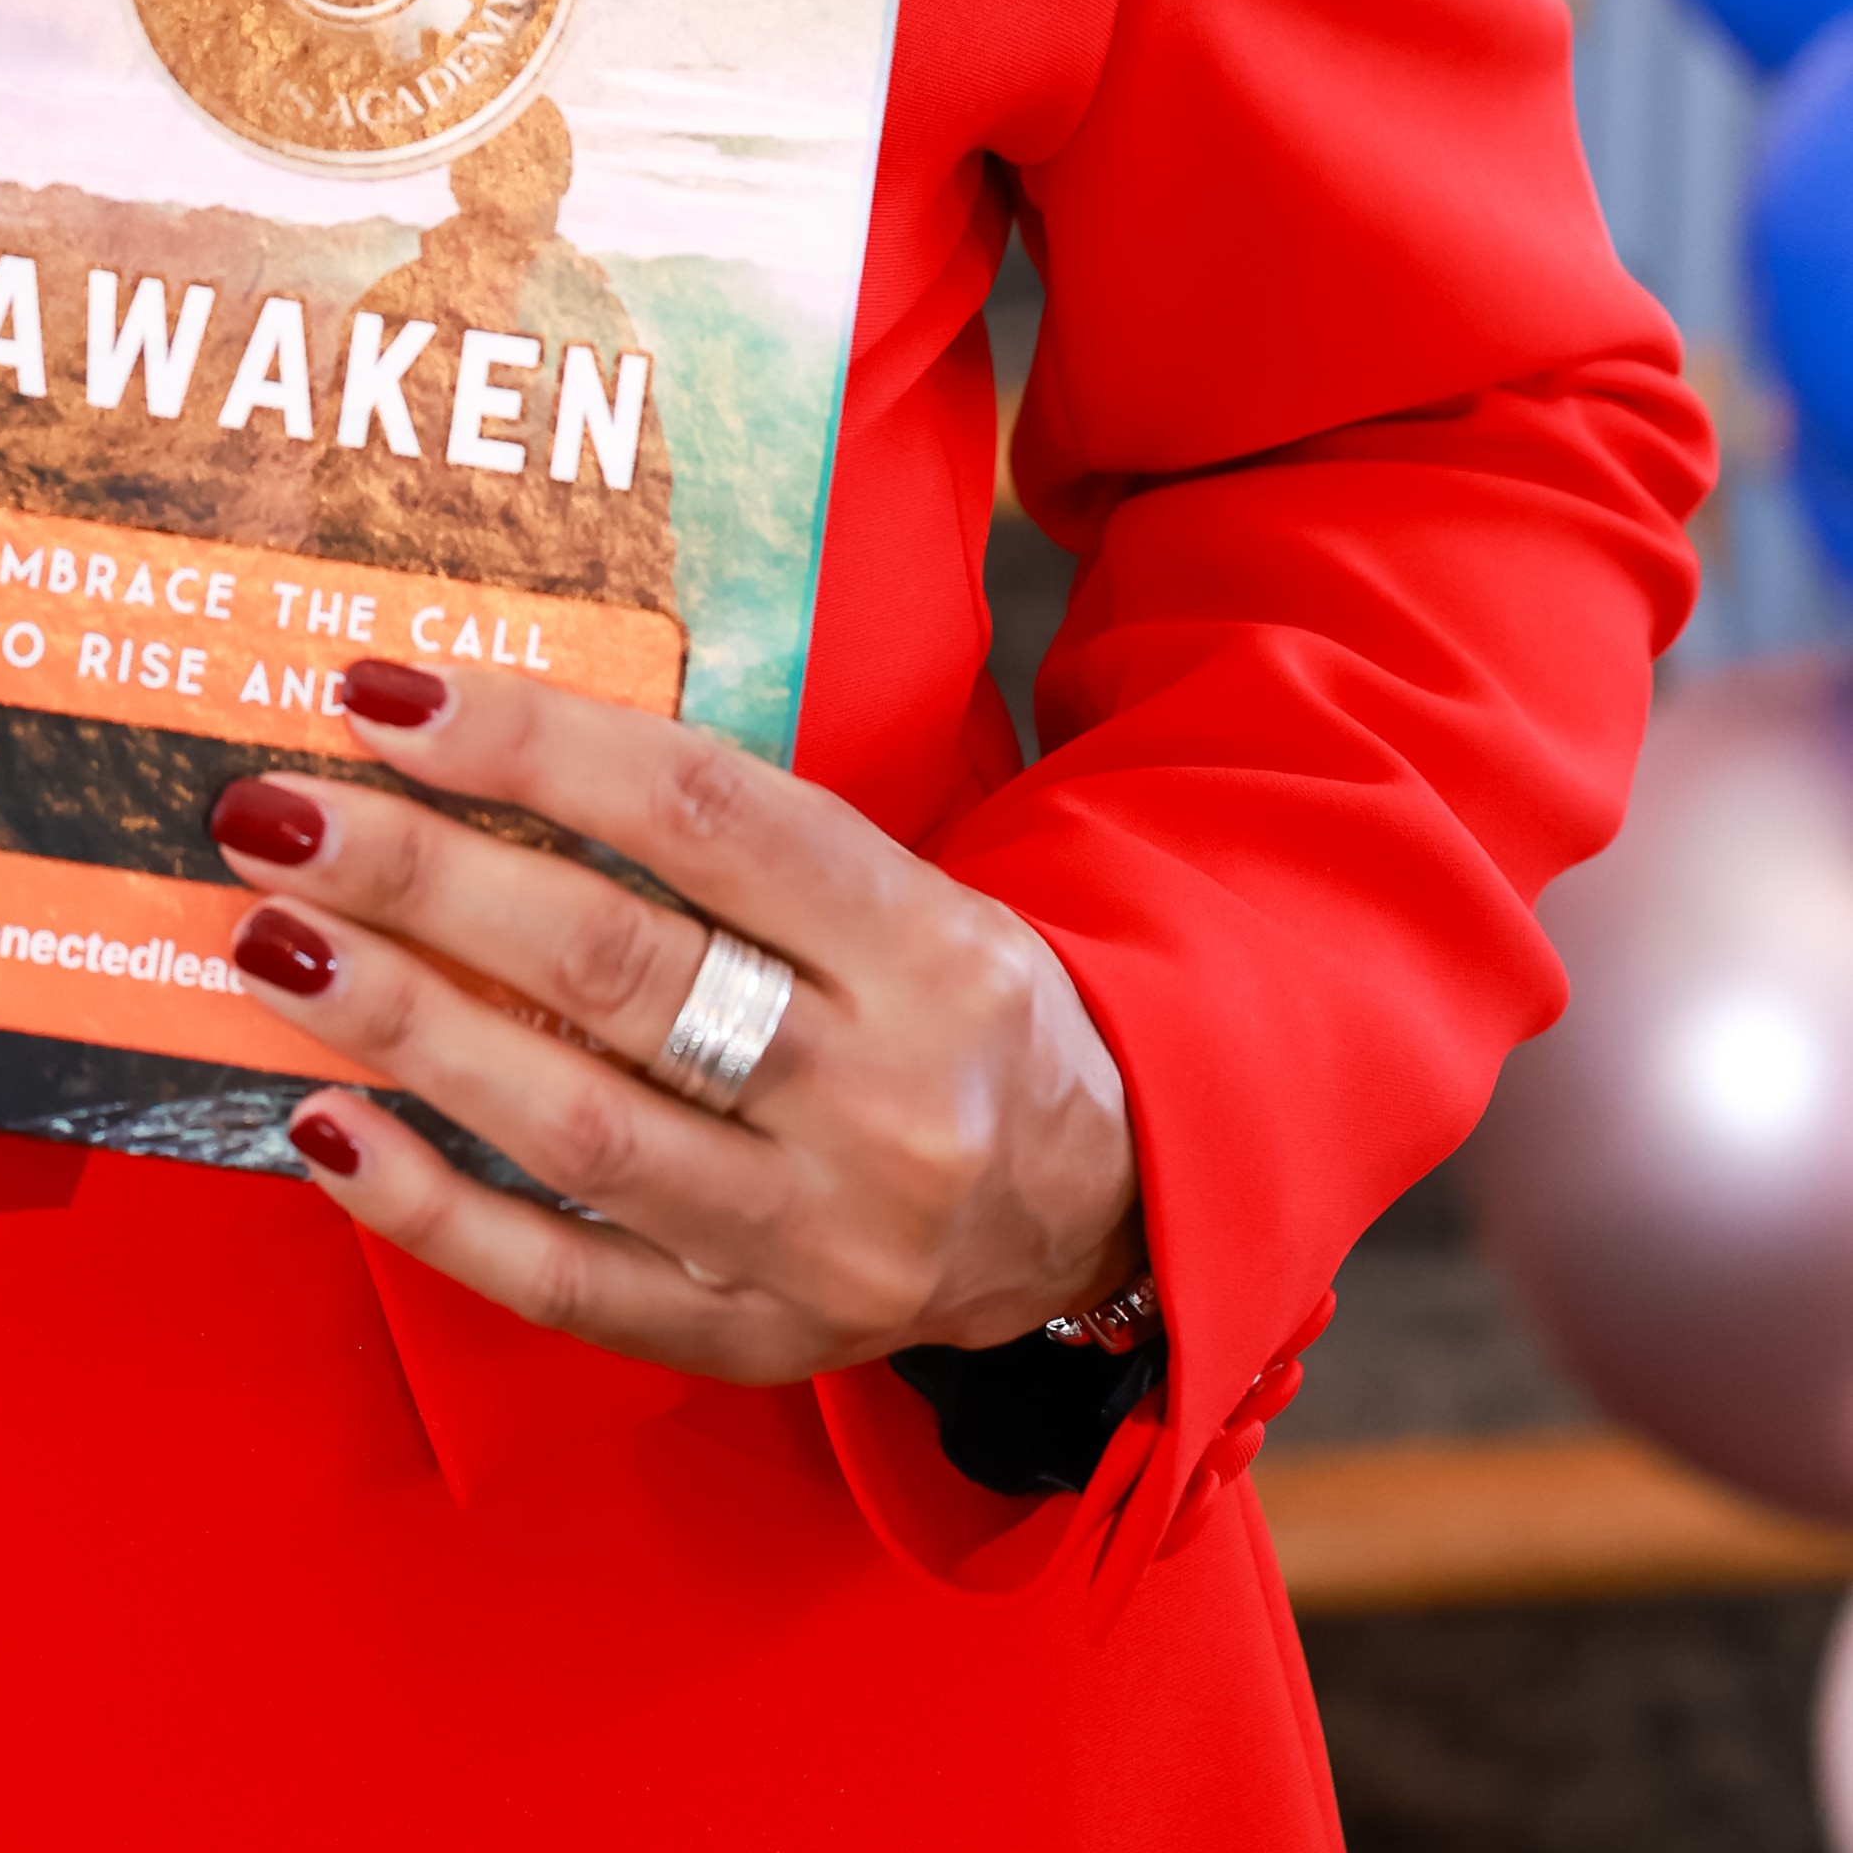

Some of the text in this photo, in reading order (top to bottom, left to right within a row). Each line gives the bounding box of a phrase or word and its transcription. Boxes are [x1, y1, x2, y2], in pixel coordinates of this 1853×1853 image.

[272, 581, 378, 642] THE
[410, 606, 551, 671] CALL
[77, 632, 208, 695] RISE
[239, 660, 347, 717] AND
